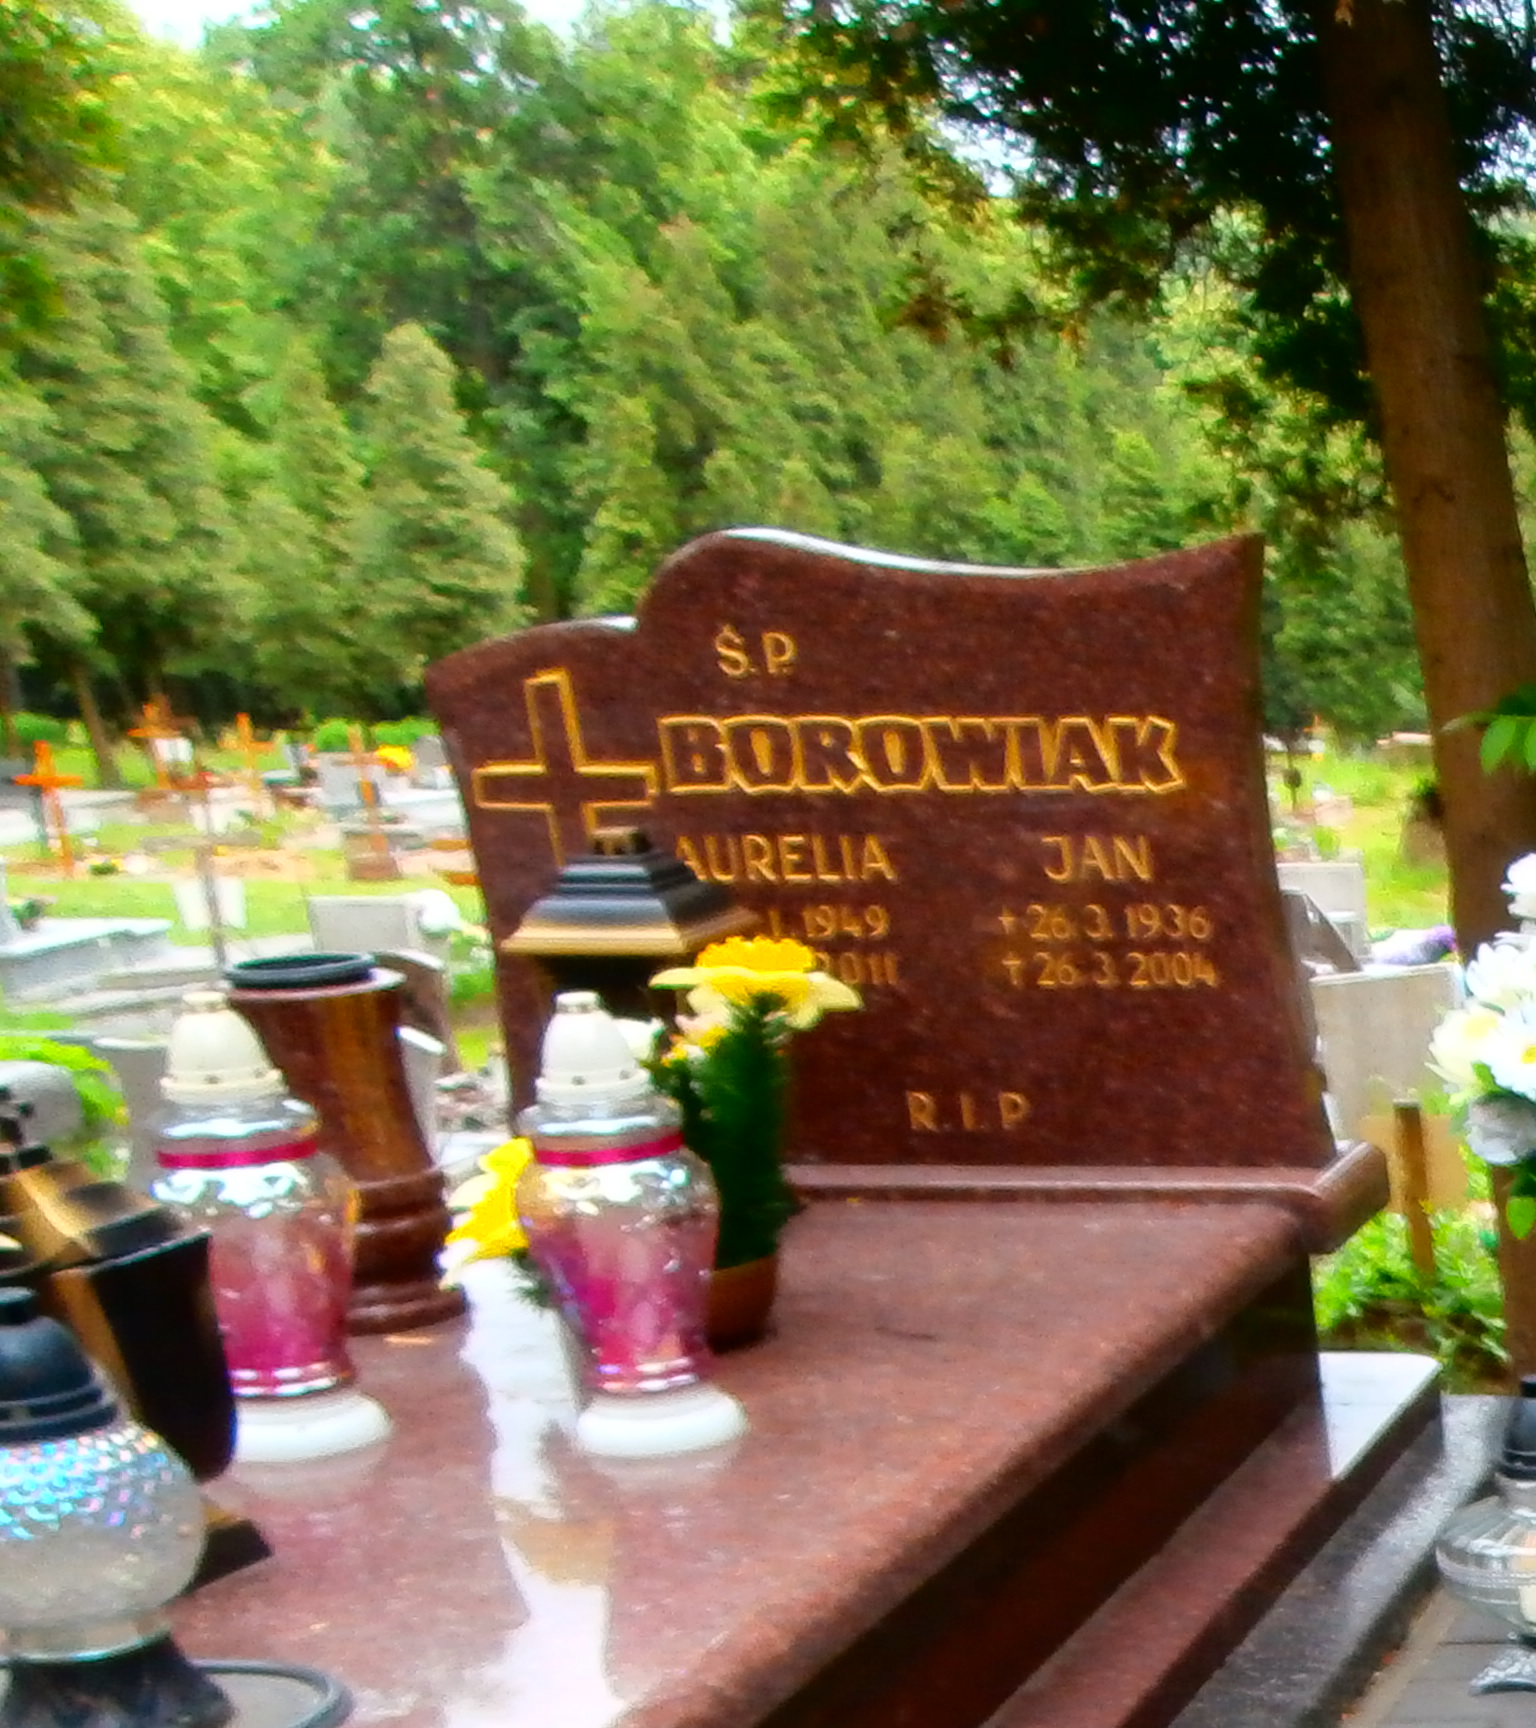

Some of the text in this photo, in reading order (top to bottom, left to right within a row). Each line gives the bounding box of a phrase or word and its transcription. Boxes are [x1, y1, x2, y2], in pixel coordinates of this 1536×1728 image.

[656, 714, 1187, 795] BOROWIAK
[675, 834, 1153, 883] AURELIA JAN
